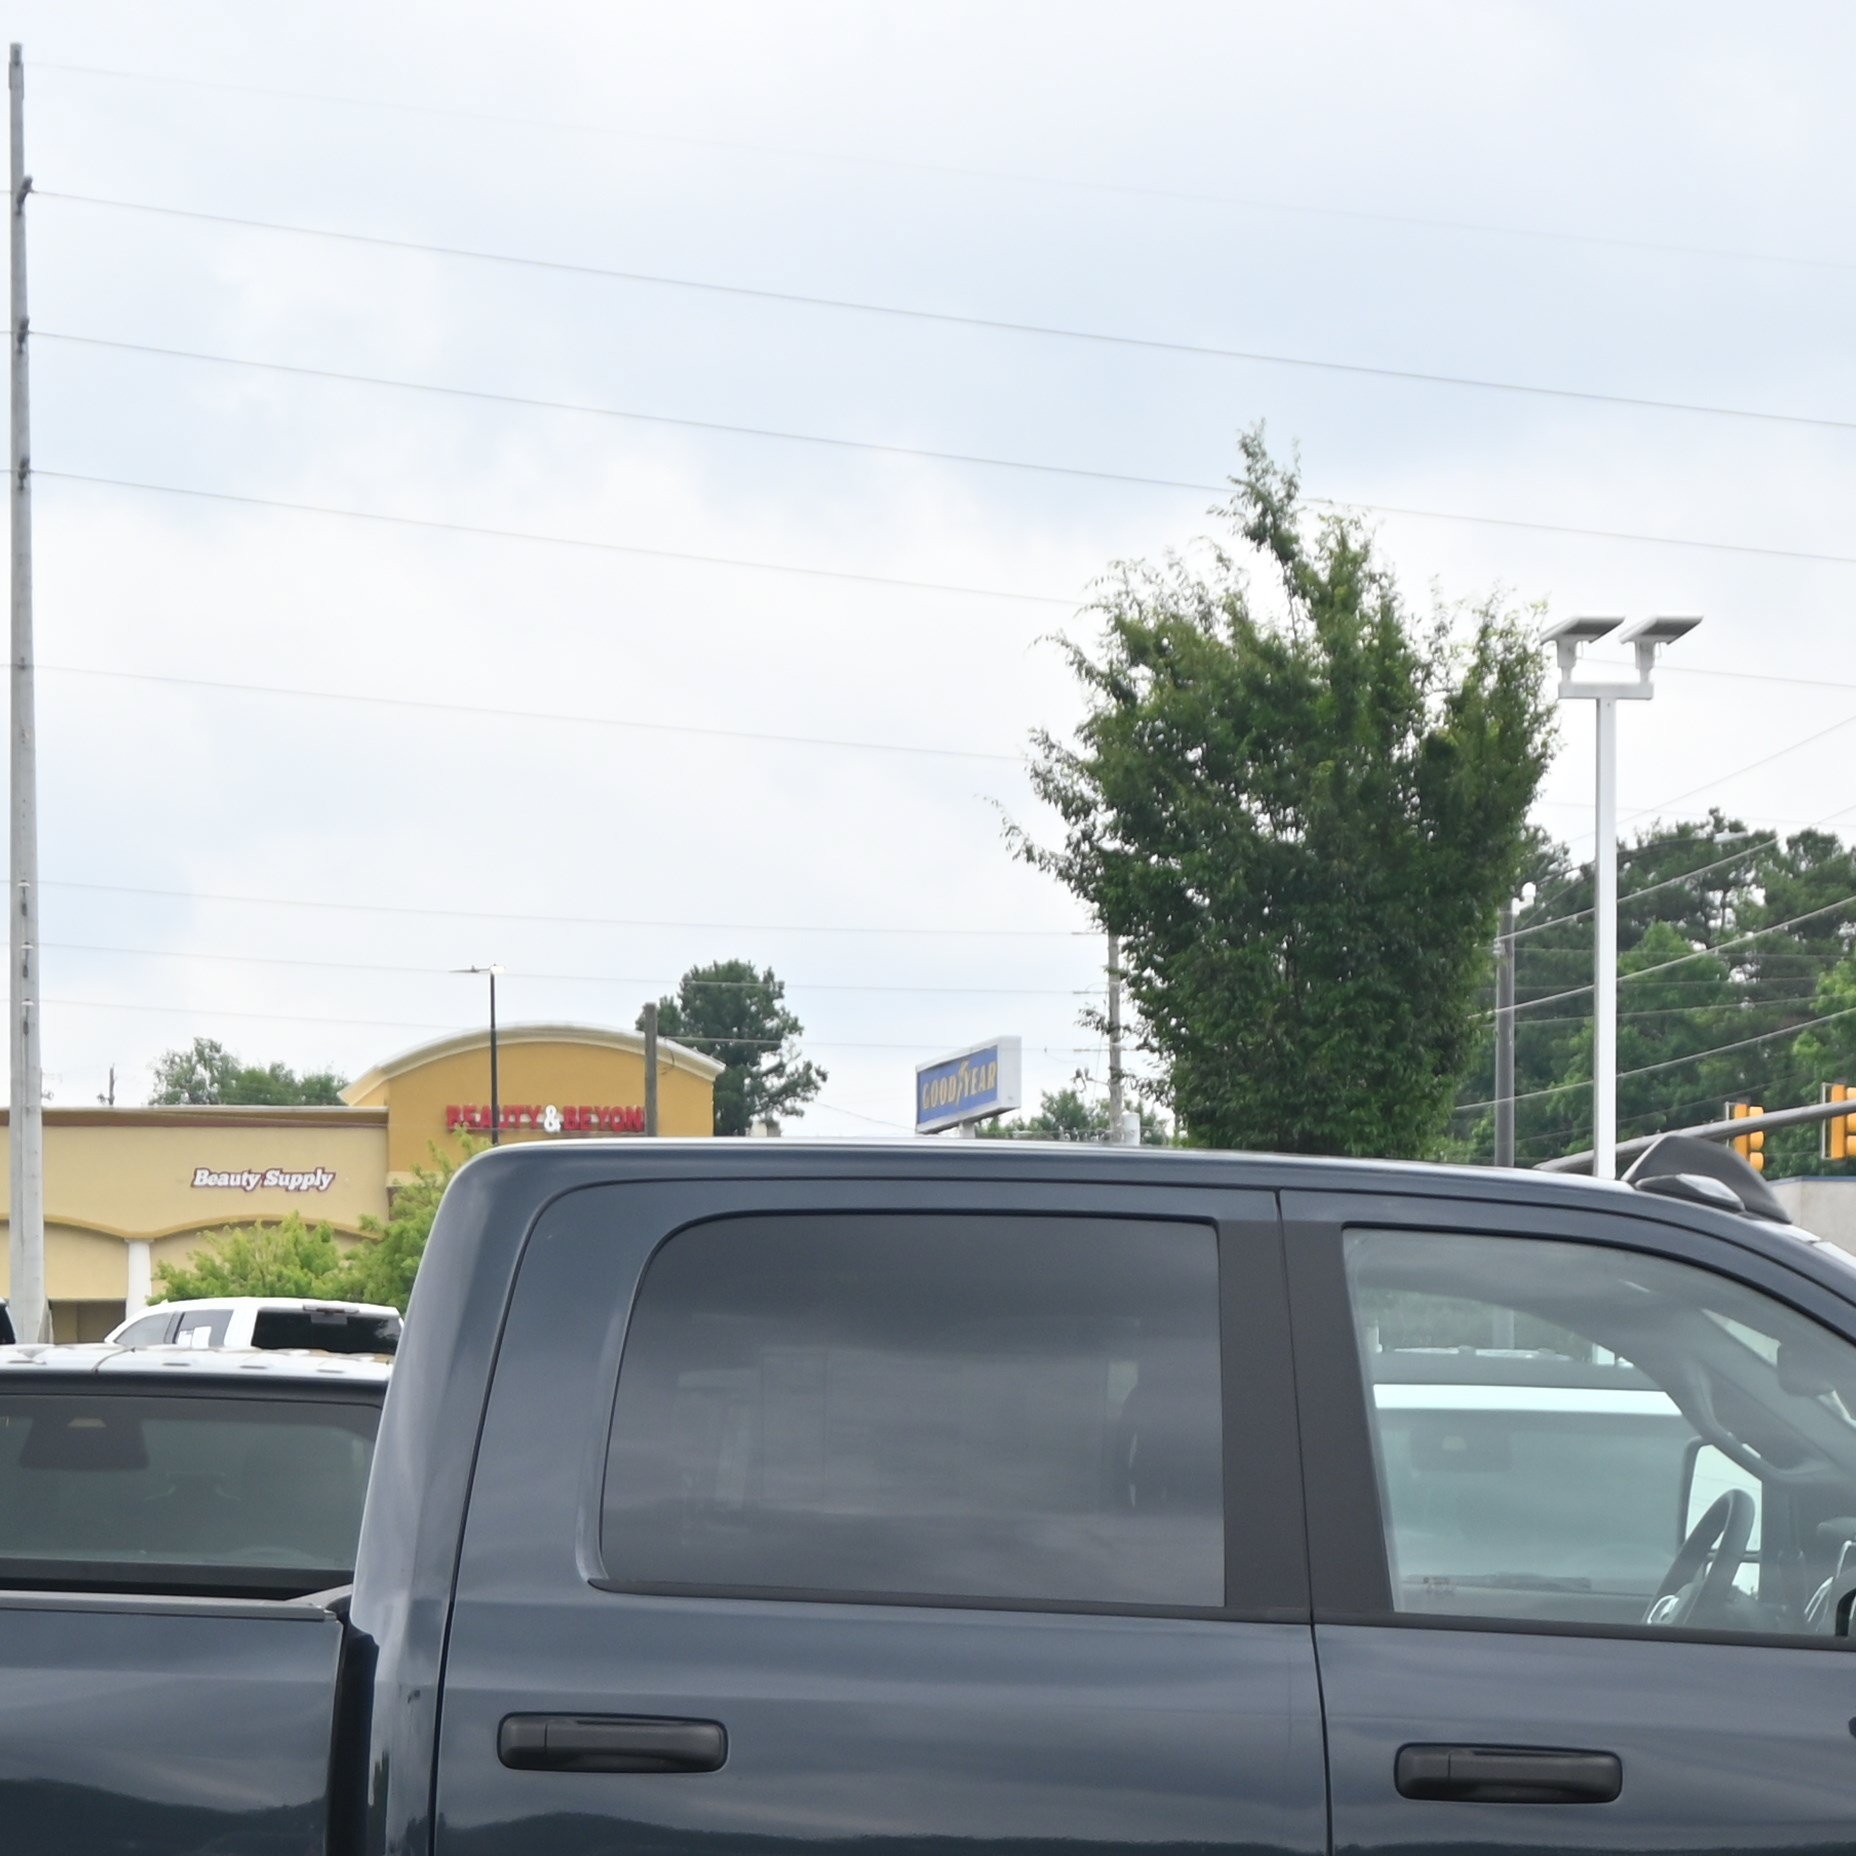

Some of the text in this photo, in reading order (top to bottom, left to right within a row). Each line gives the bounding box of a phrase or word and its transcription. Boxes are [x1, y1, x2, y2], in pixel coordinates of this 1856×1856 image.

[922, 1061, 997, 1110] GOODYEAR
[544, 1105, 561, 1132] &
[191, 1168, 335, 1192] Beauty Supply
